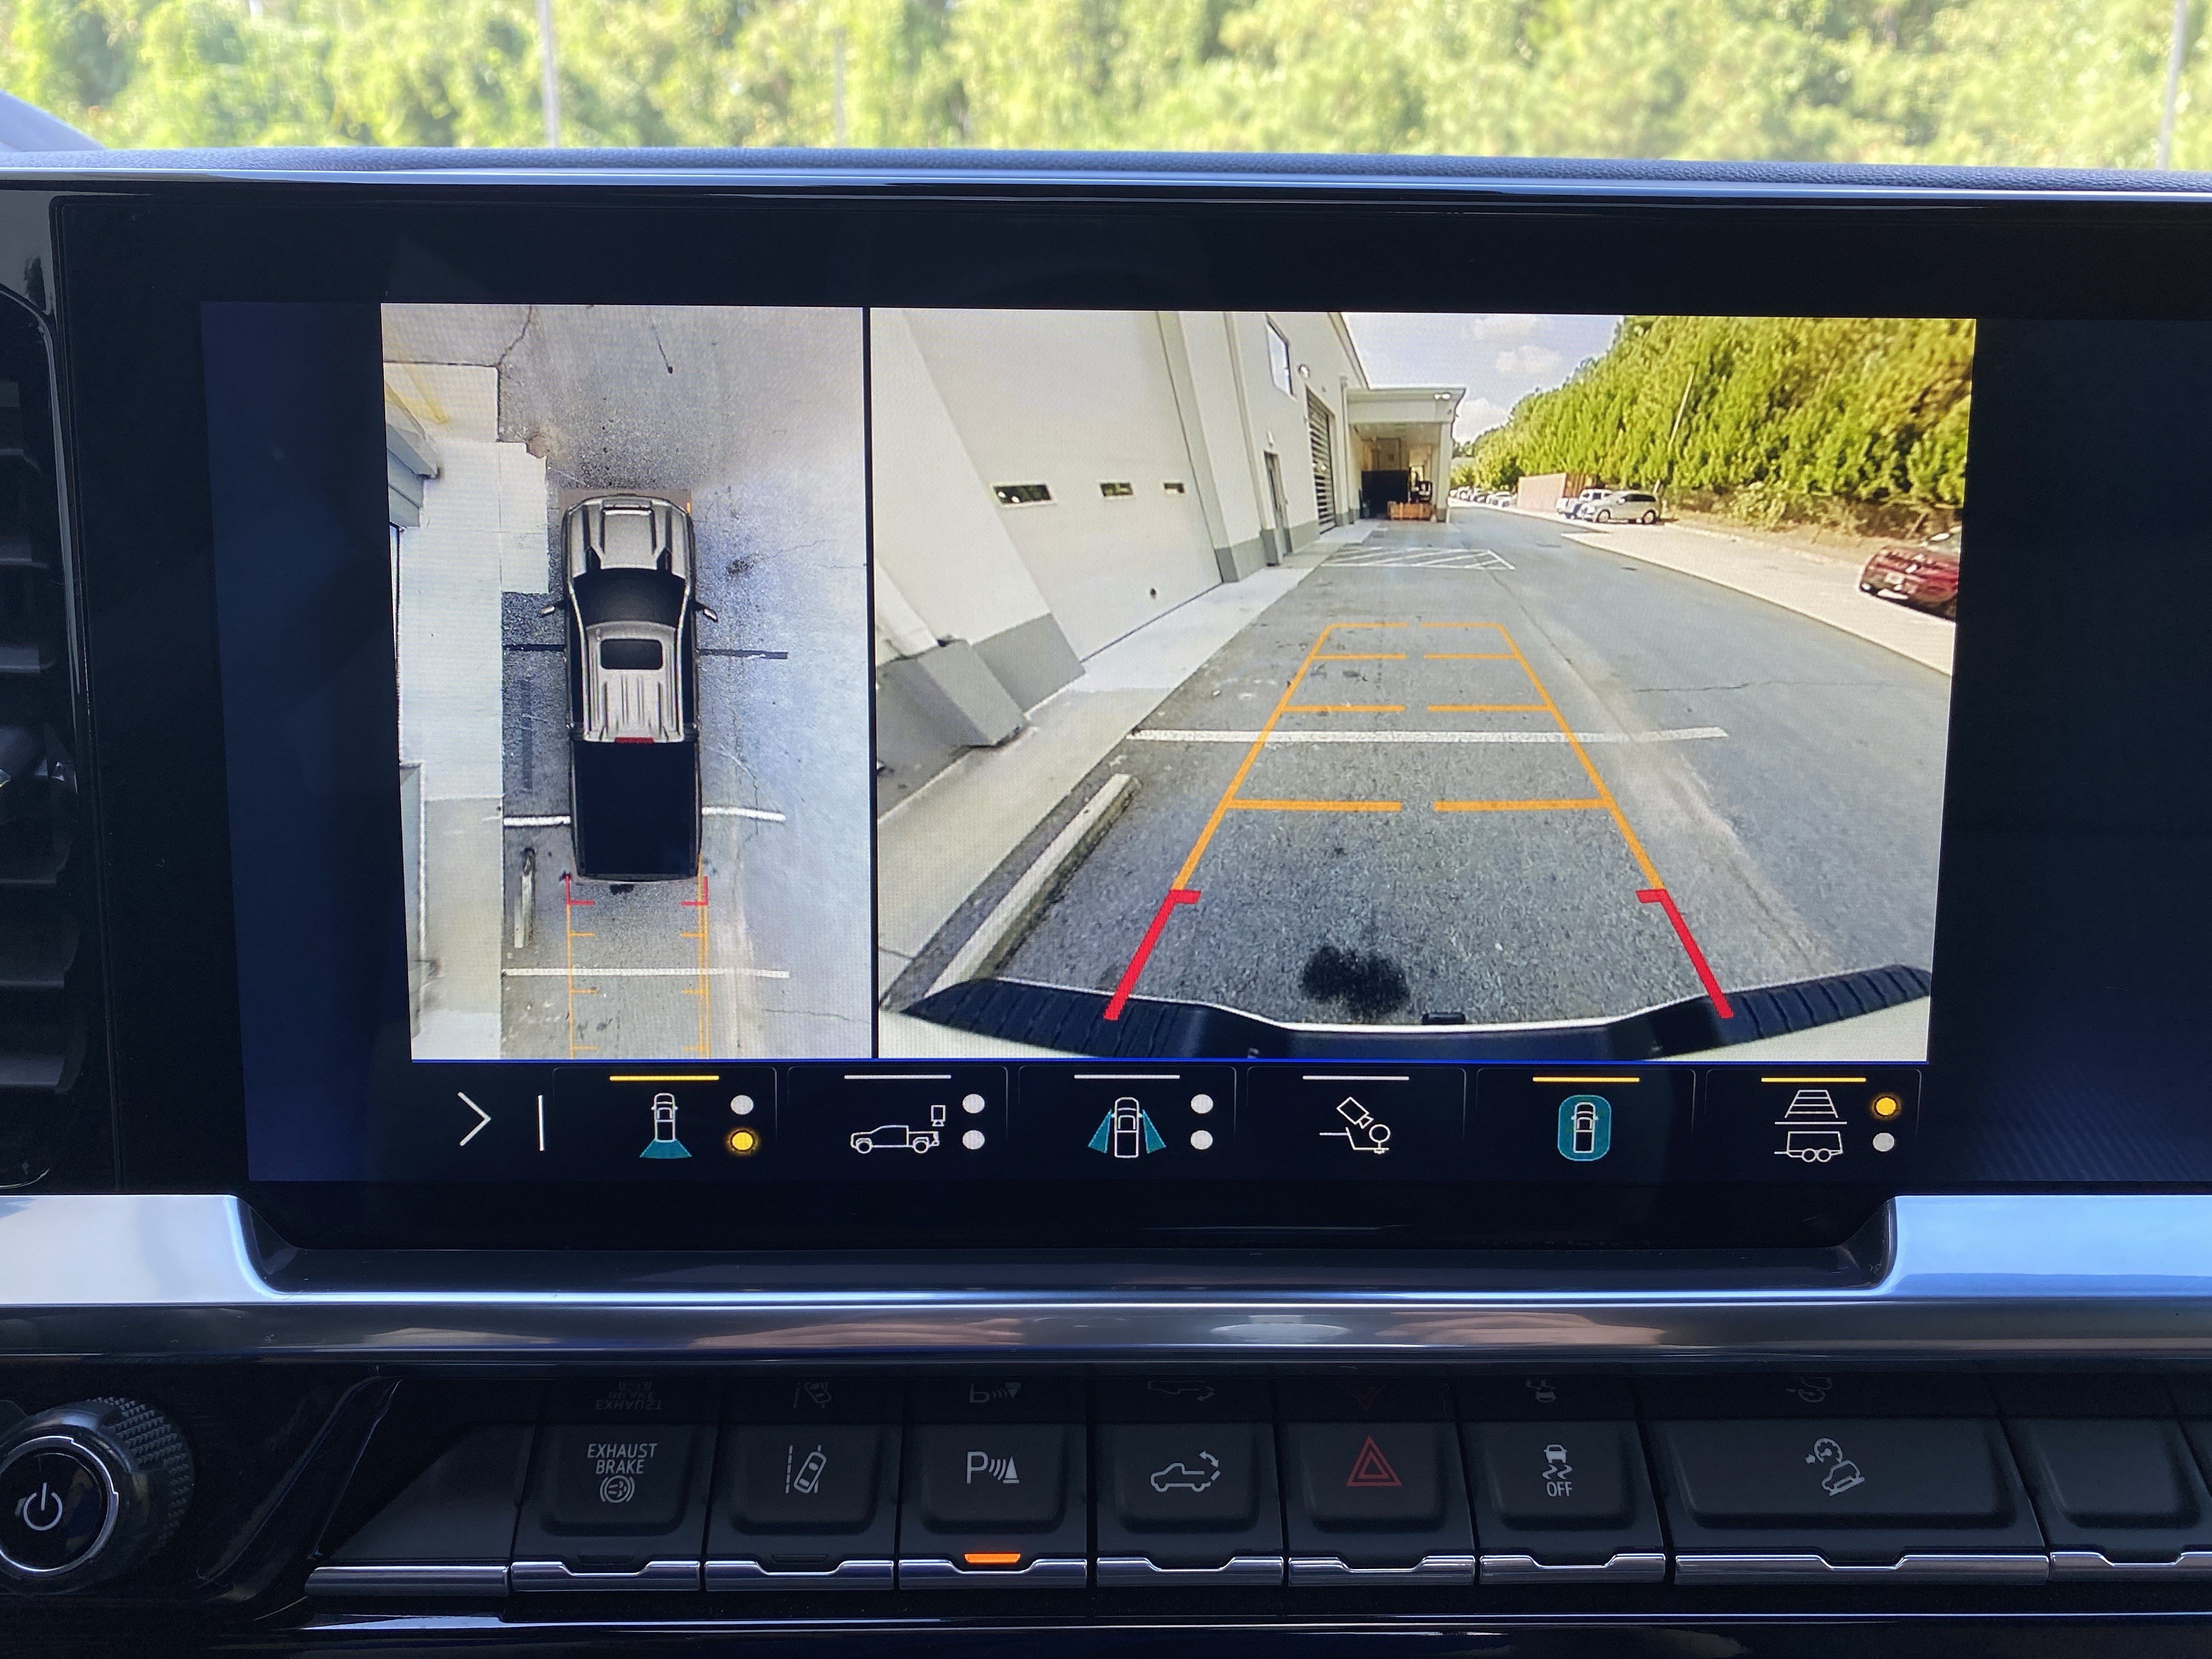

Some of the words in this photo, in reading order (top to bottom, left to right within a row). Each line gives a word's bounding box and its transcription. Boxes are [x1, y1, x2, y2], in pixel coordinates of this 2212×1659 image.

[587, 1443, 658, 1458] EXHAUST
[595, 1459, 646, 1474] BRAKE
[1546, 1481, 1573, 1497] OFF
